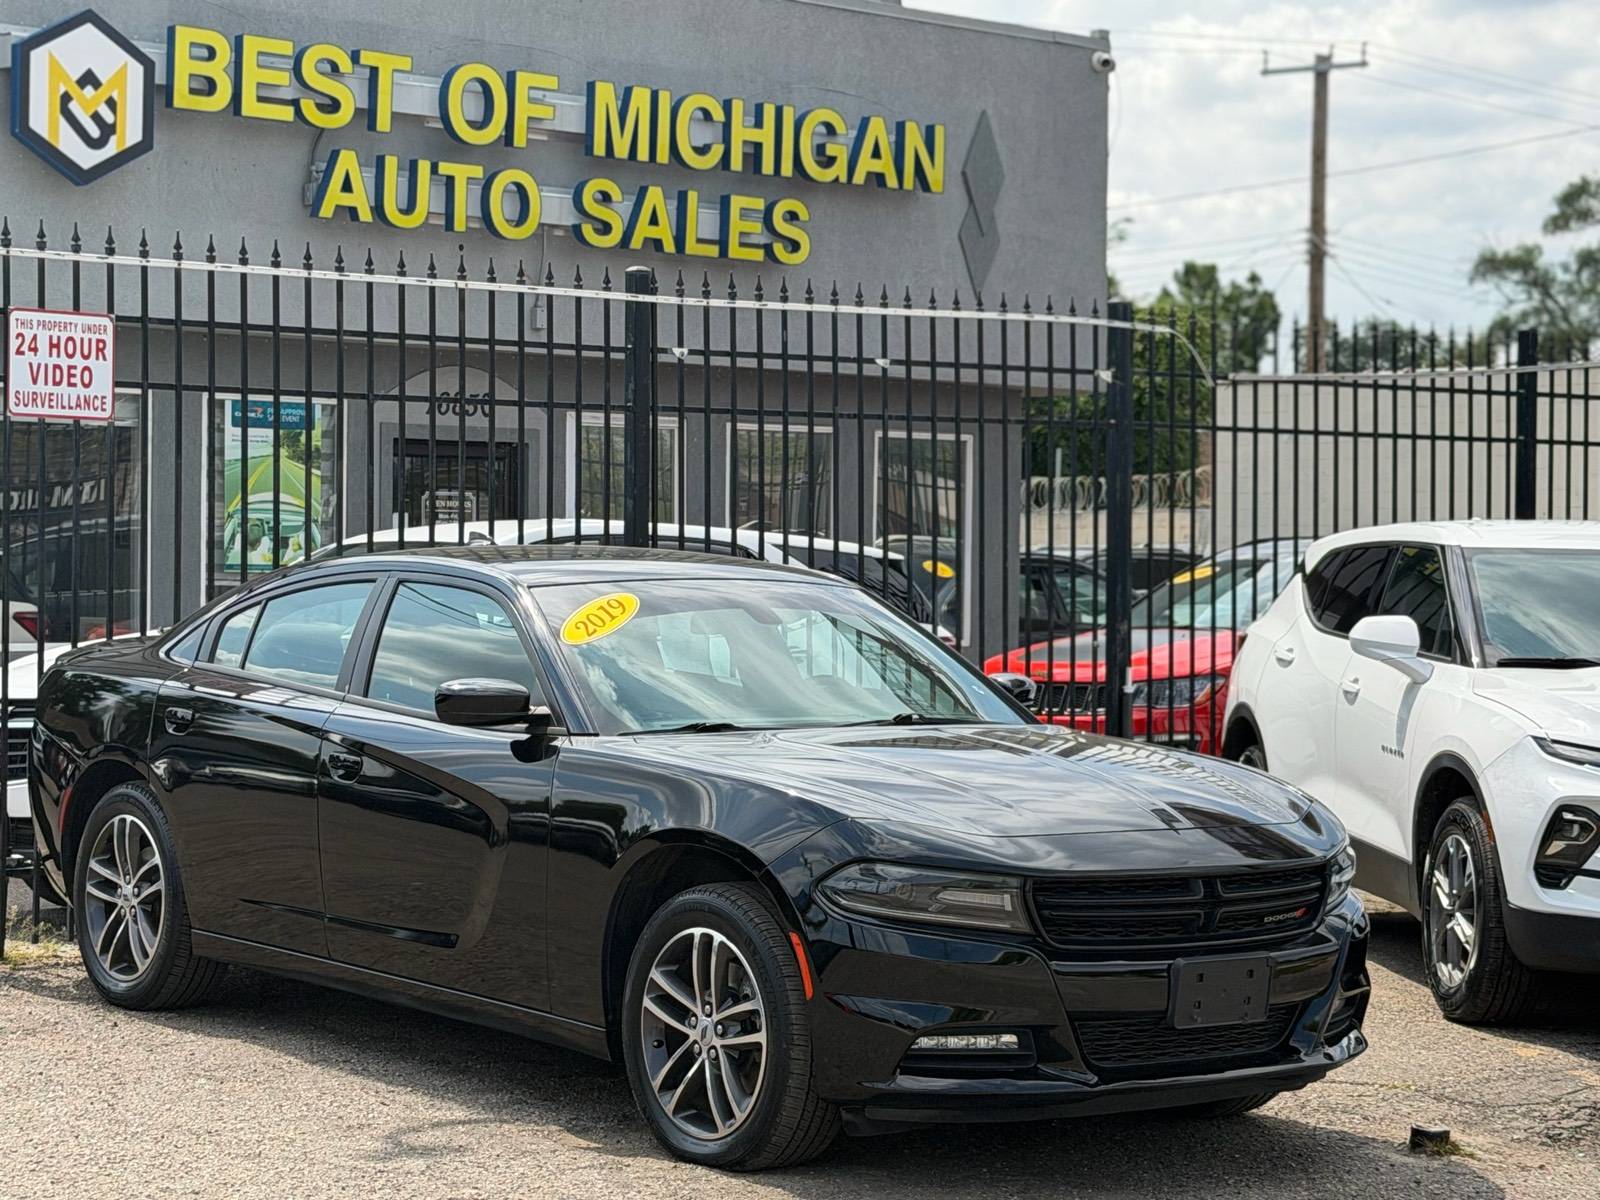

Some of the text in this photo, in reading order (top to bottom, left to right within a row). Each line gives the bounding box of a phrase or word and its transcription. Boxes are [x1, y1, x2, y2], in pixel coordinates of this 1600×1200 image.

[166, 24, 946, 194] BEST OF MICHIGAN
[310, 148, 811, 266] AUTO SALES
[15, 318, 108, 335] THIS PROPERTY UNDER
[15, 332, 108, 361] 24 HOUR
[28, 361, 93, 389] VIDEO
[14, 390, 107, 412] SURVEILLANCE
[575, 598, 626, 637] 2019
